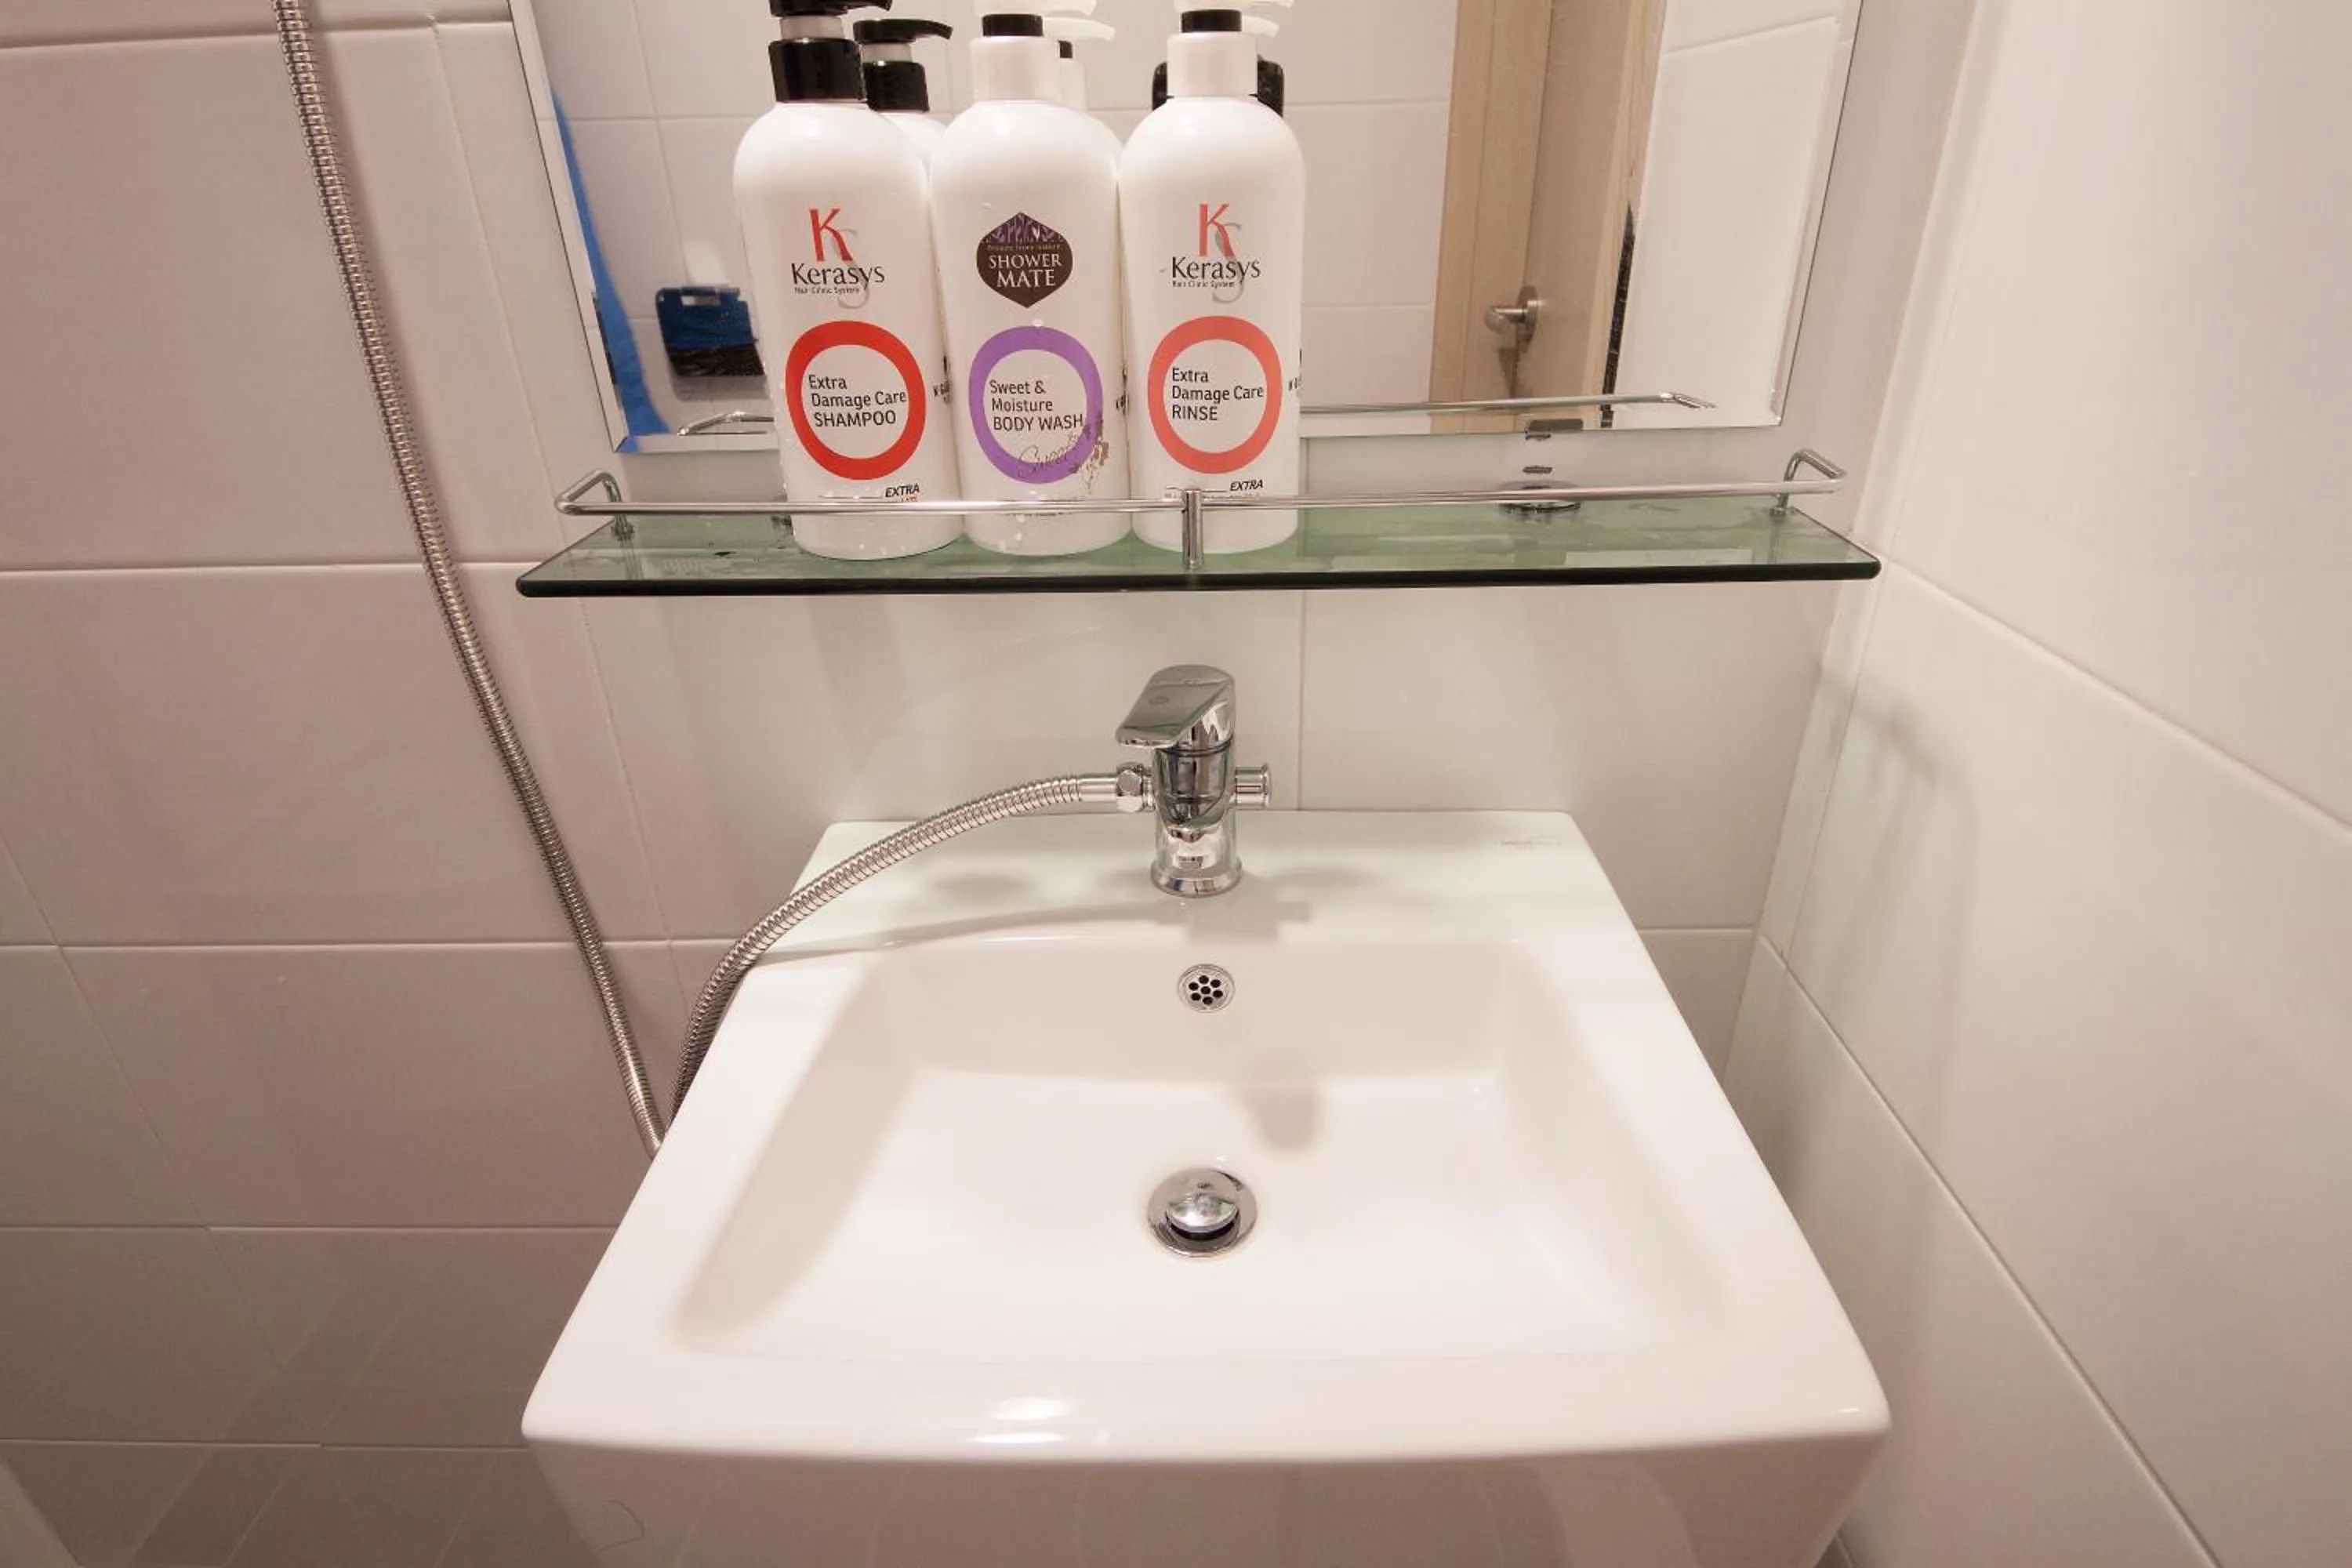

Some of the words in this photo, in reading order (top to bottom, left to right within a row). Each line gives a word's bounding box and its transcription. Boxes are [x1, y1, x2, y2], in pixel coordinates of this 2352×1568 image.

[989, 253, 1062, 269] SHOWER
[791, 263, 885, 290] Kerasys
[1171, 256, 1261, 283] Kerasys
[996, 269, 1055, 288] MATE
[808, 375, 848, 390] Extra
[1172, 368, 1209, 383] Extra
[989, 379, 1031, 394] Sweet
[1034, 380, 1046, 394] &
[1172, 386, 1230, 403] Damage
[1233, 385, 1264, 400] Care
[811, 393, 871, 409] Damage
[875, 390, 907, 405] Care
[992, 397, 1054, 412] Moisture
[814, 410, 896, 427] SHAMPOO
[1172, 405, 1218, 421] RINSE
[993, 417, 1034, 431] BODY
[1038, 413, 1083, 431] WASH
[885, 483, 920, 498] EXTRA
[1230, 479, 1264, 492] EXTRA
